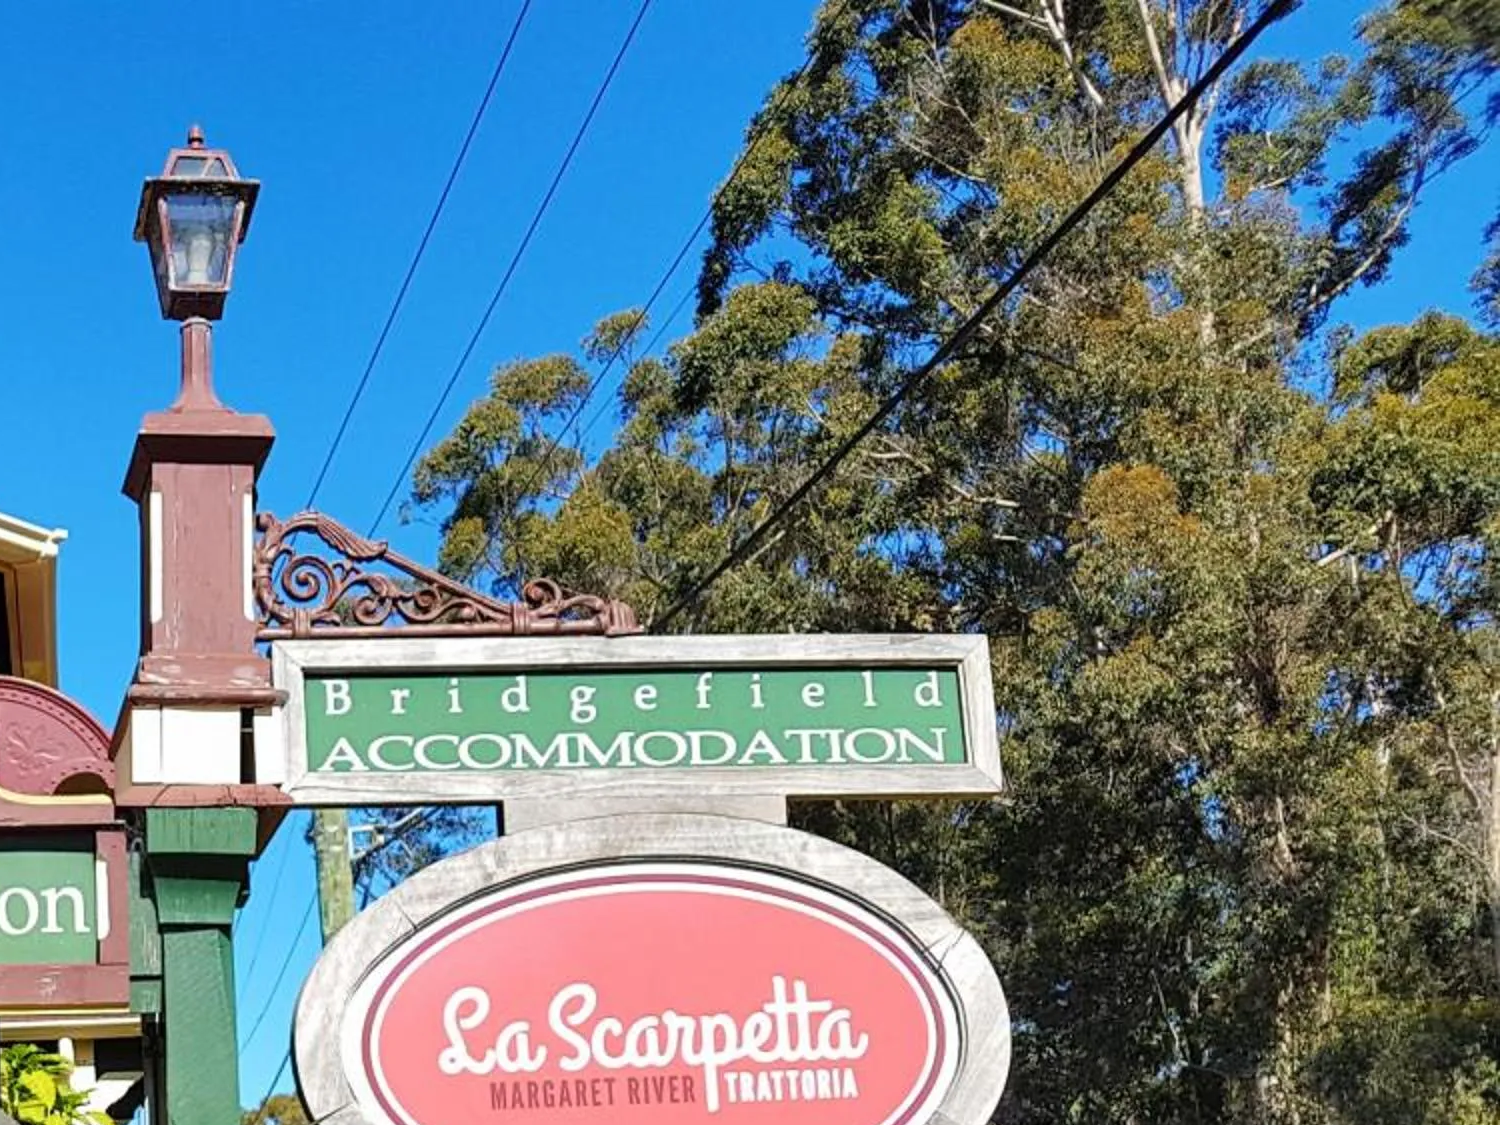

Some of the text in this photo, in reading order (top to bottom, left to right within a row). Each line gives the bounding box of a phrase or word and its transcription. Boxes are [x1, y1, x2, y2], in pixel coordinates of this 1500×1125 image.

[323, 672, 942, 721] Bridgefield
[320, 728, 947, 771] ACCOMMODATION
[437, 975, 870, 1112] La Scarpetta
[489, 1068, 859, 1110] MARGARET RIVER TRATTORIA
